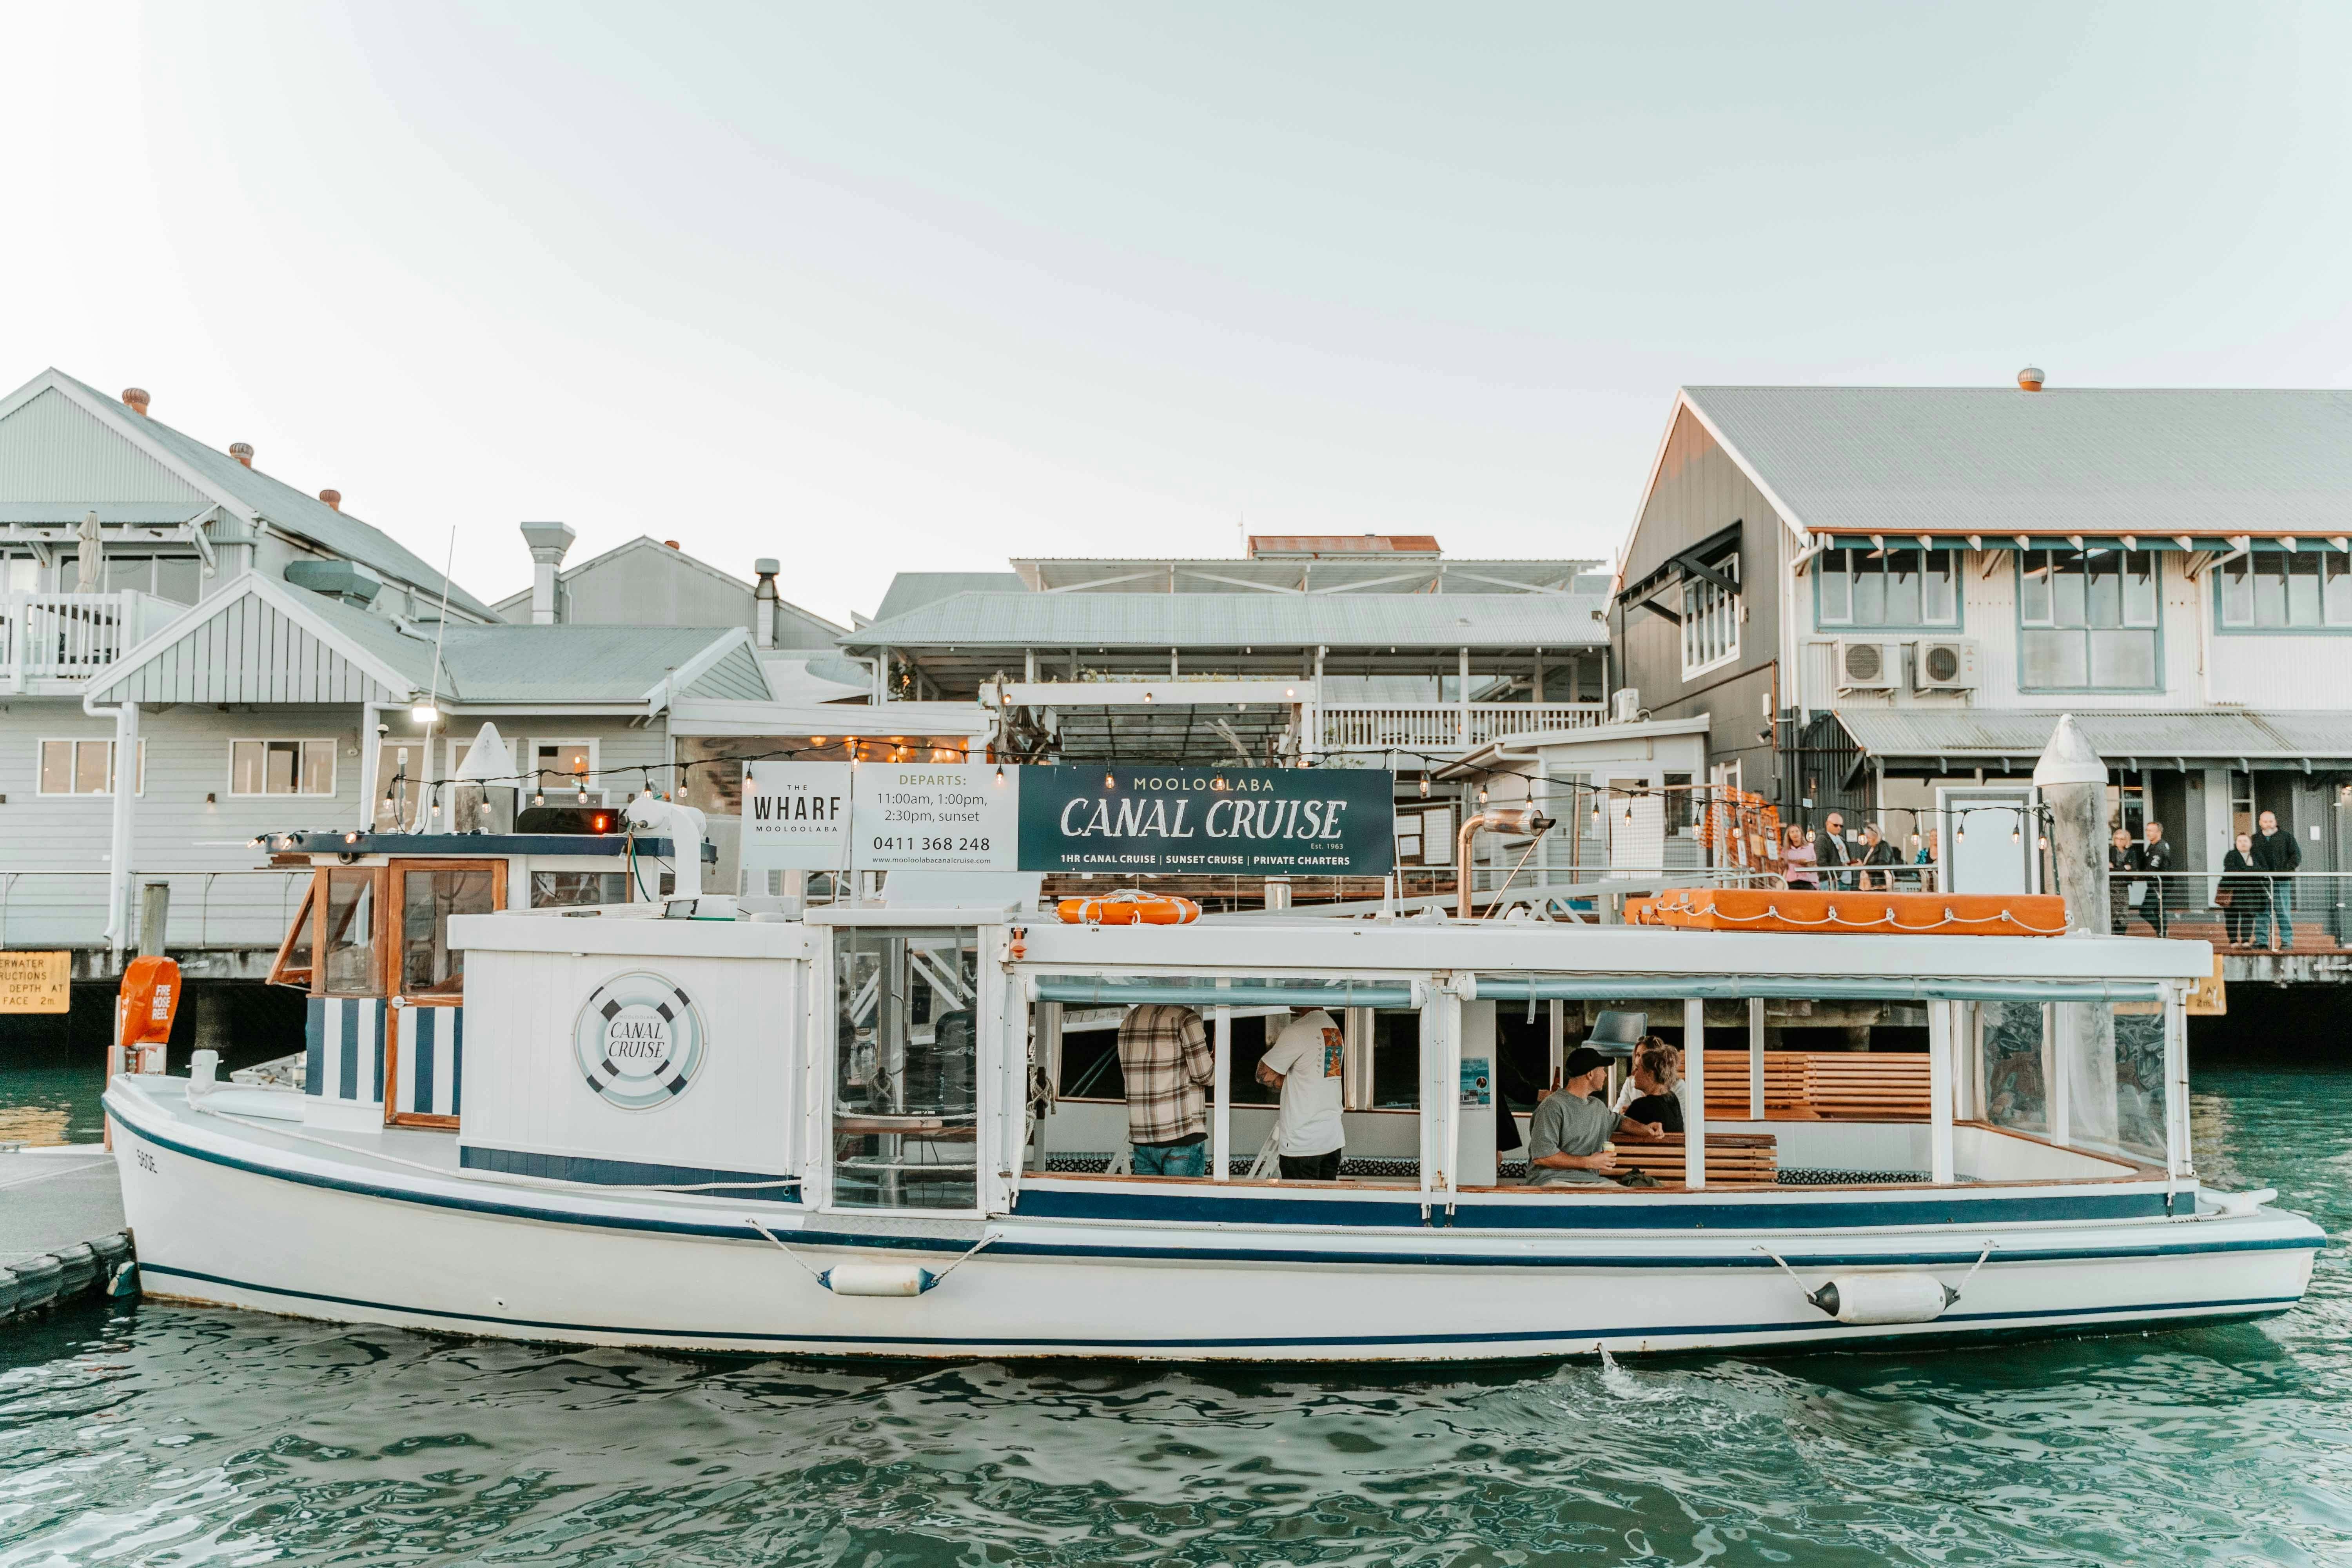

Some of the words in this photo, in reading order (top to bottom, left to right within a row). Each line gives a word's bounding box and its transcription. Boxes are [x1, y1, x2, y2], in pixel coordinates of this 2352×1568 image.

[899, 775, 966, 785] DEPARTS:
[1134, 778, 1274, 791] MOOLOOLABA
[878, 793, 933, 806] 11:00am,
[938, 794, 987, 807] 1:00pm,
[754, 797, 840, 820] WHARF
[885, 810, 935, 824] 2:30pm,
[939, 811, 980, 822] sunset
[1061, 798, 1194, 837] CANAL
[1206, 800, 1347, 839] CRUISE
[874, 837, 913, 850] 0411
[922, 837, 952, 850] 368
[959, 838, 990, 851] 248
[1061, 855, 1080, 863] 1HR
[1083, 855, 1117, 863] CANAL
[1120, 855, 1156, 863] CRUISE
[1166, 855, 1205, 864] SUNSET
[1207, 856, 1243, 864] CRUISE
[1254, 856, 1295, 864] PRIVATE
[1298, 857, 1350, 865] CHARTERS
[10, 984, 41, 993] DEPTH
[51, 984, 63, 993] AT
[156, 984, 171, 996] FIRE
[152, 996, 171, 1008] HOSE
[152, 1008, 169, 1020] REEL
[611, 1022, 663, 1039] CANAL
[609, 1041, 665, 1058] CRUISE
